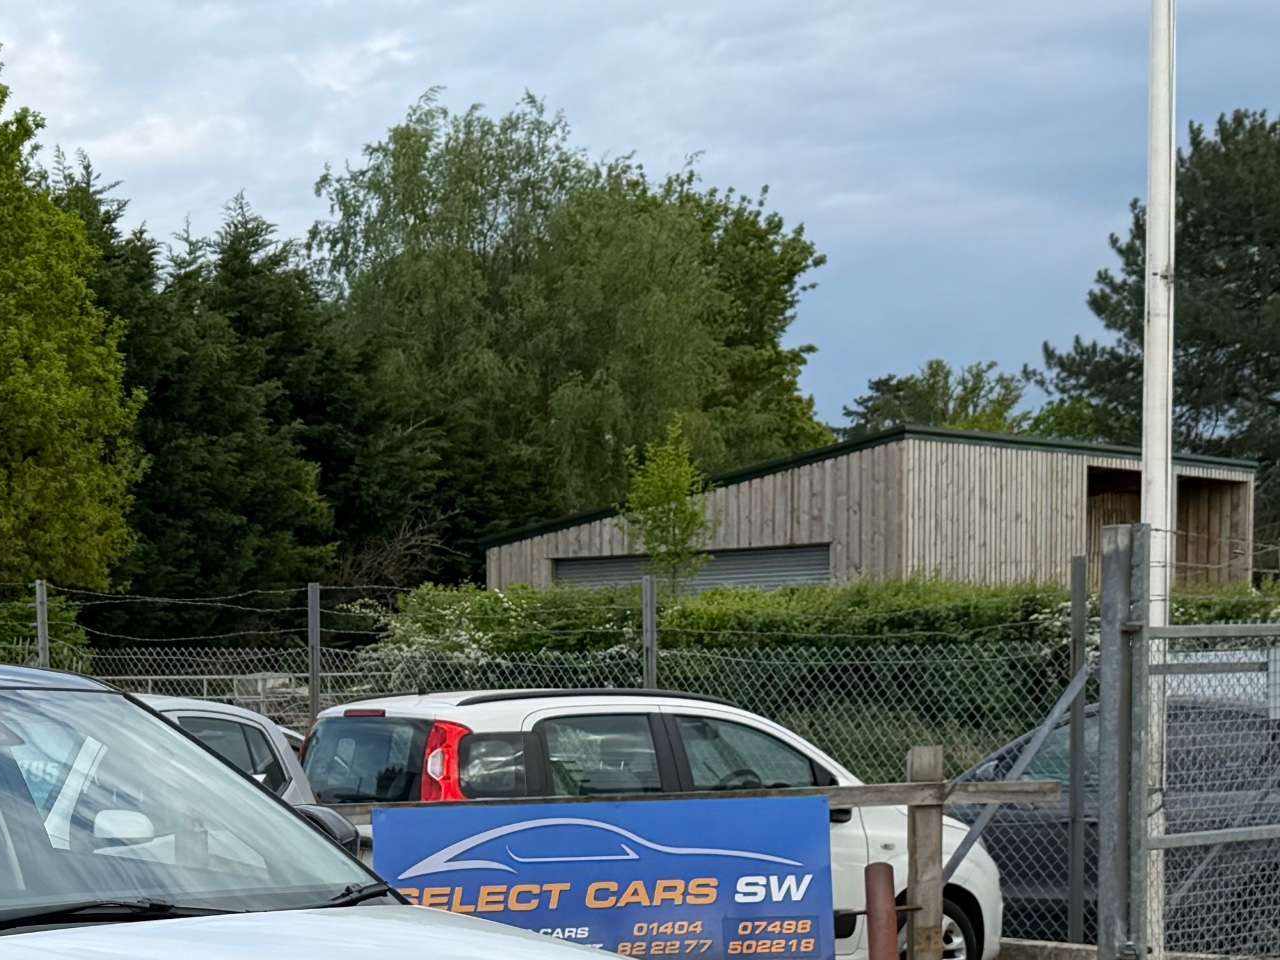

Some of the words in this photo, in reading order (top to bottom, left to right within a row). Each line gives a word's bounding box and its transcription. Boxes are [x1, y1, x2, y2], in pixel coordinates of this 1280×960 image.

[585, 878, 719, 909] CARS
[735, 874, 813, 903] SW
[634, 920, 703, 936] 01404
[738, 920, 812, 935] 07498
[728, 938, 815, 954] 502218
